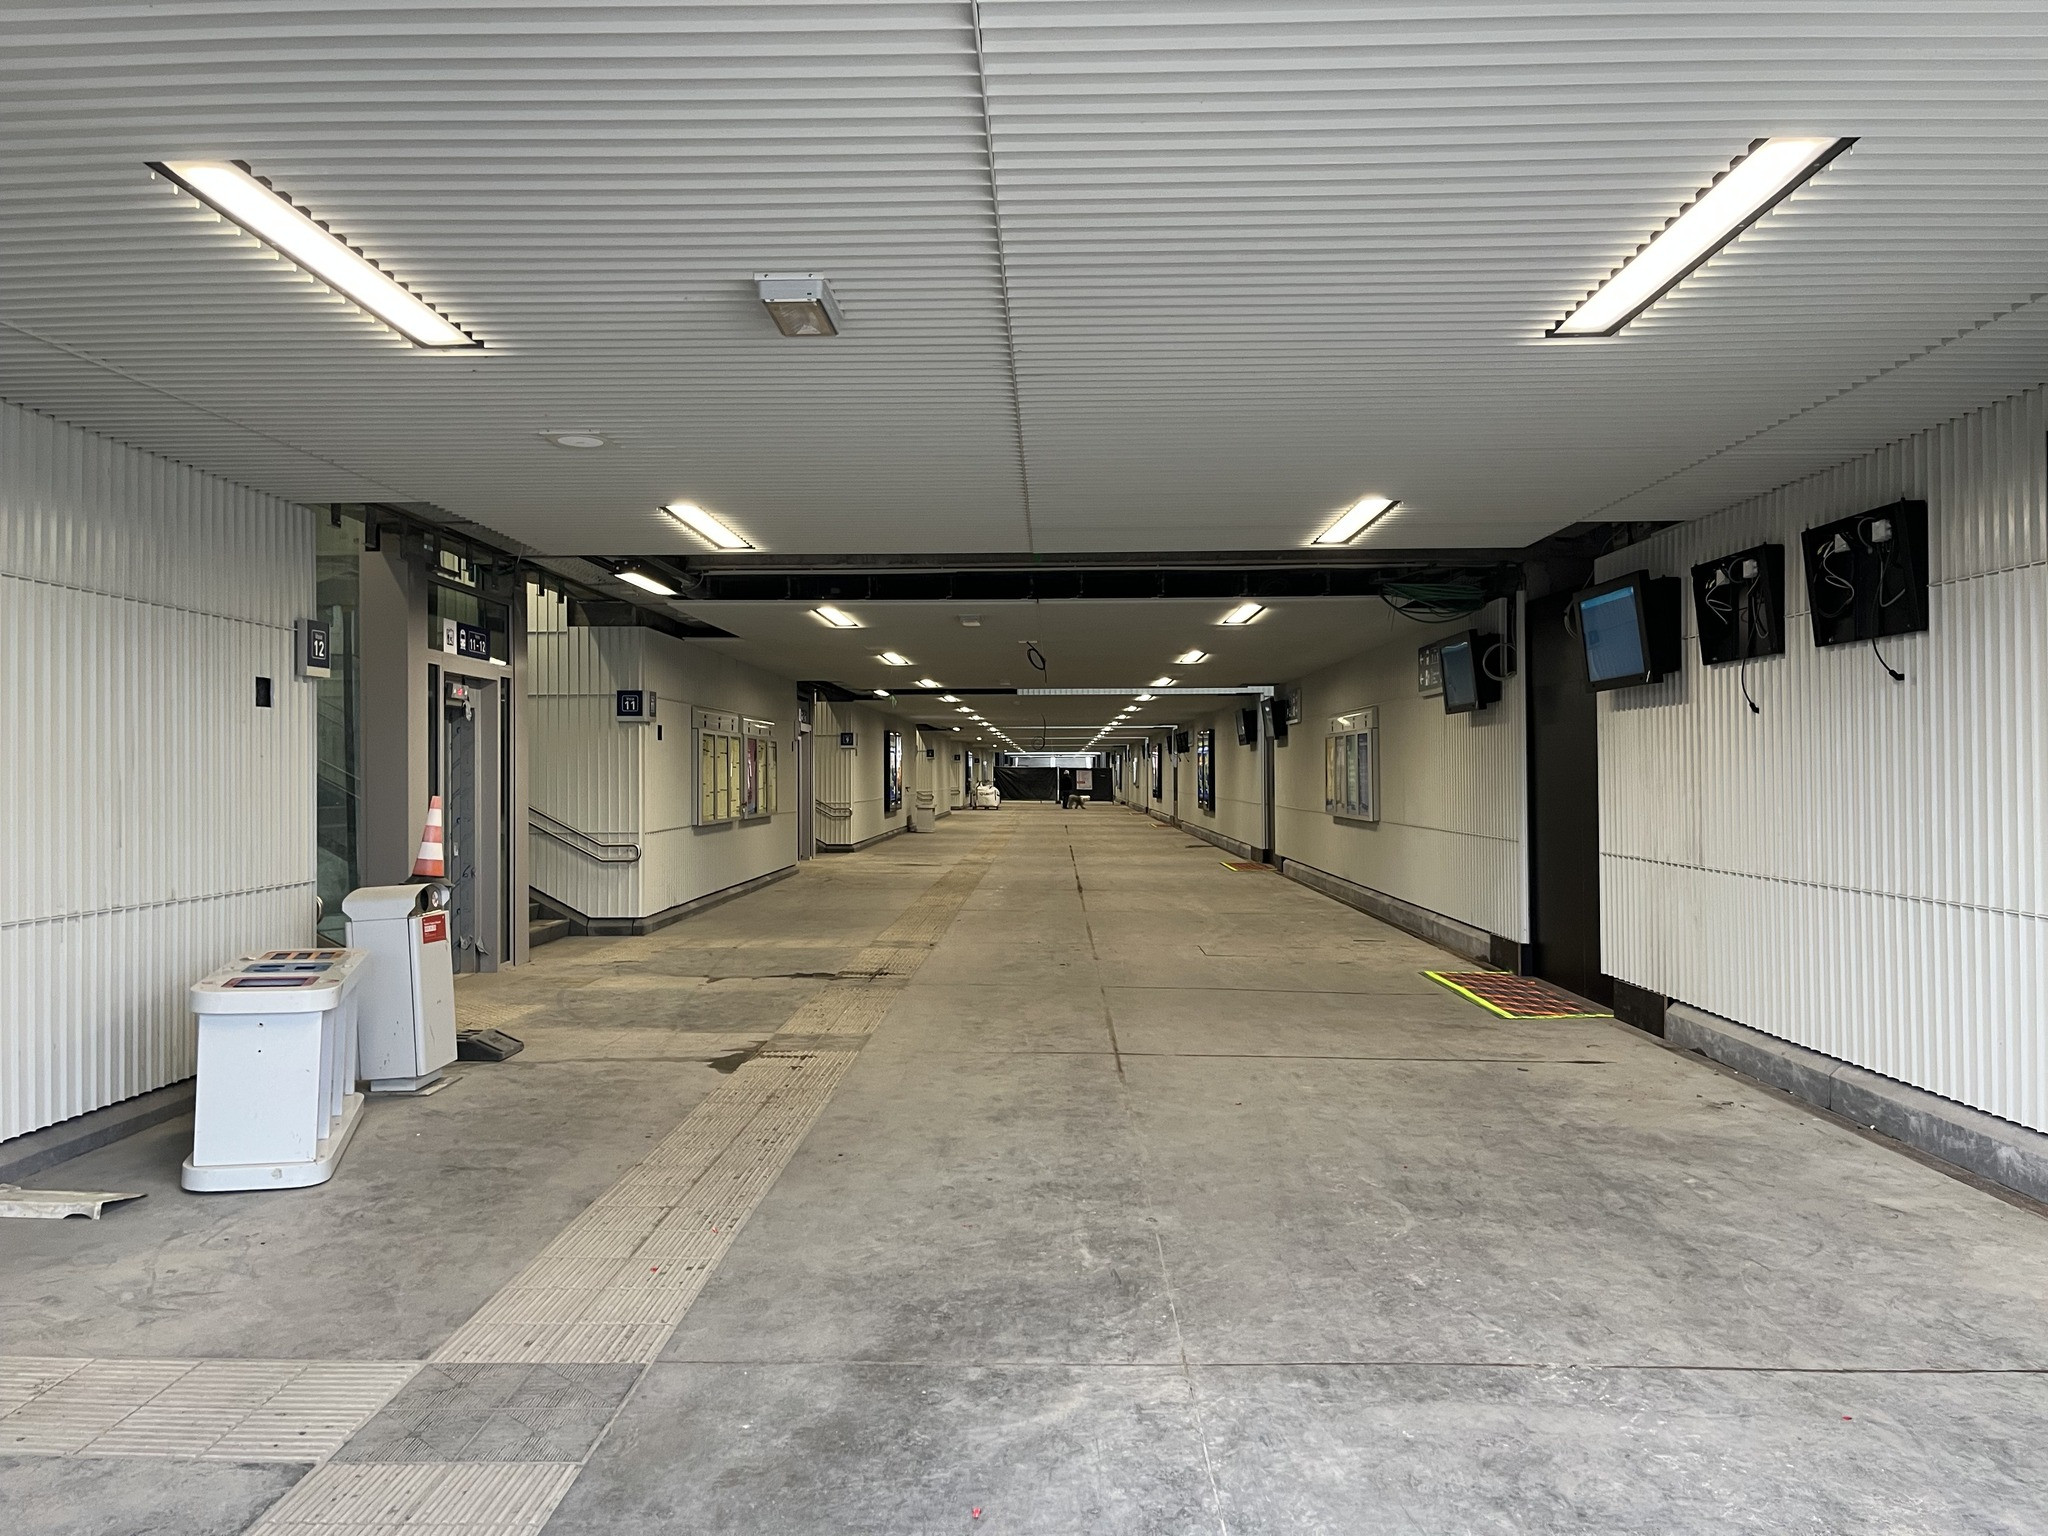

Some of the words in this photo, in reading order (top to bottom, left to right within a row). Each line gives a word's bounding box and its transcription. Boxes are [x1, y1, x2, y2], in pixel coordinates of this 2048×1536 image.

[314, 640, 325, 656] 12
[470, 638, 486, 652] 11-12
[624, 700, 636, 710] 11
